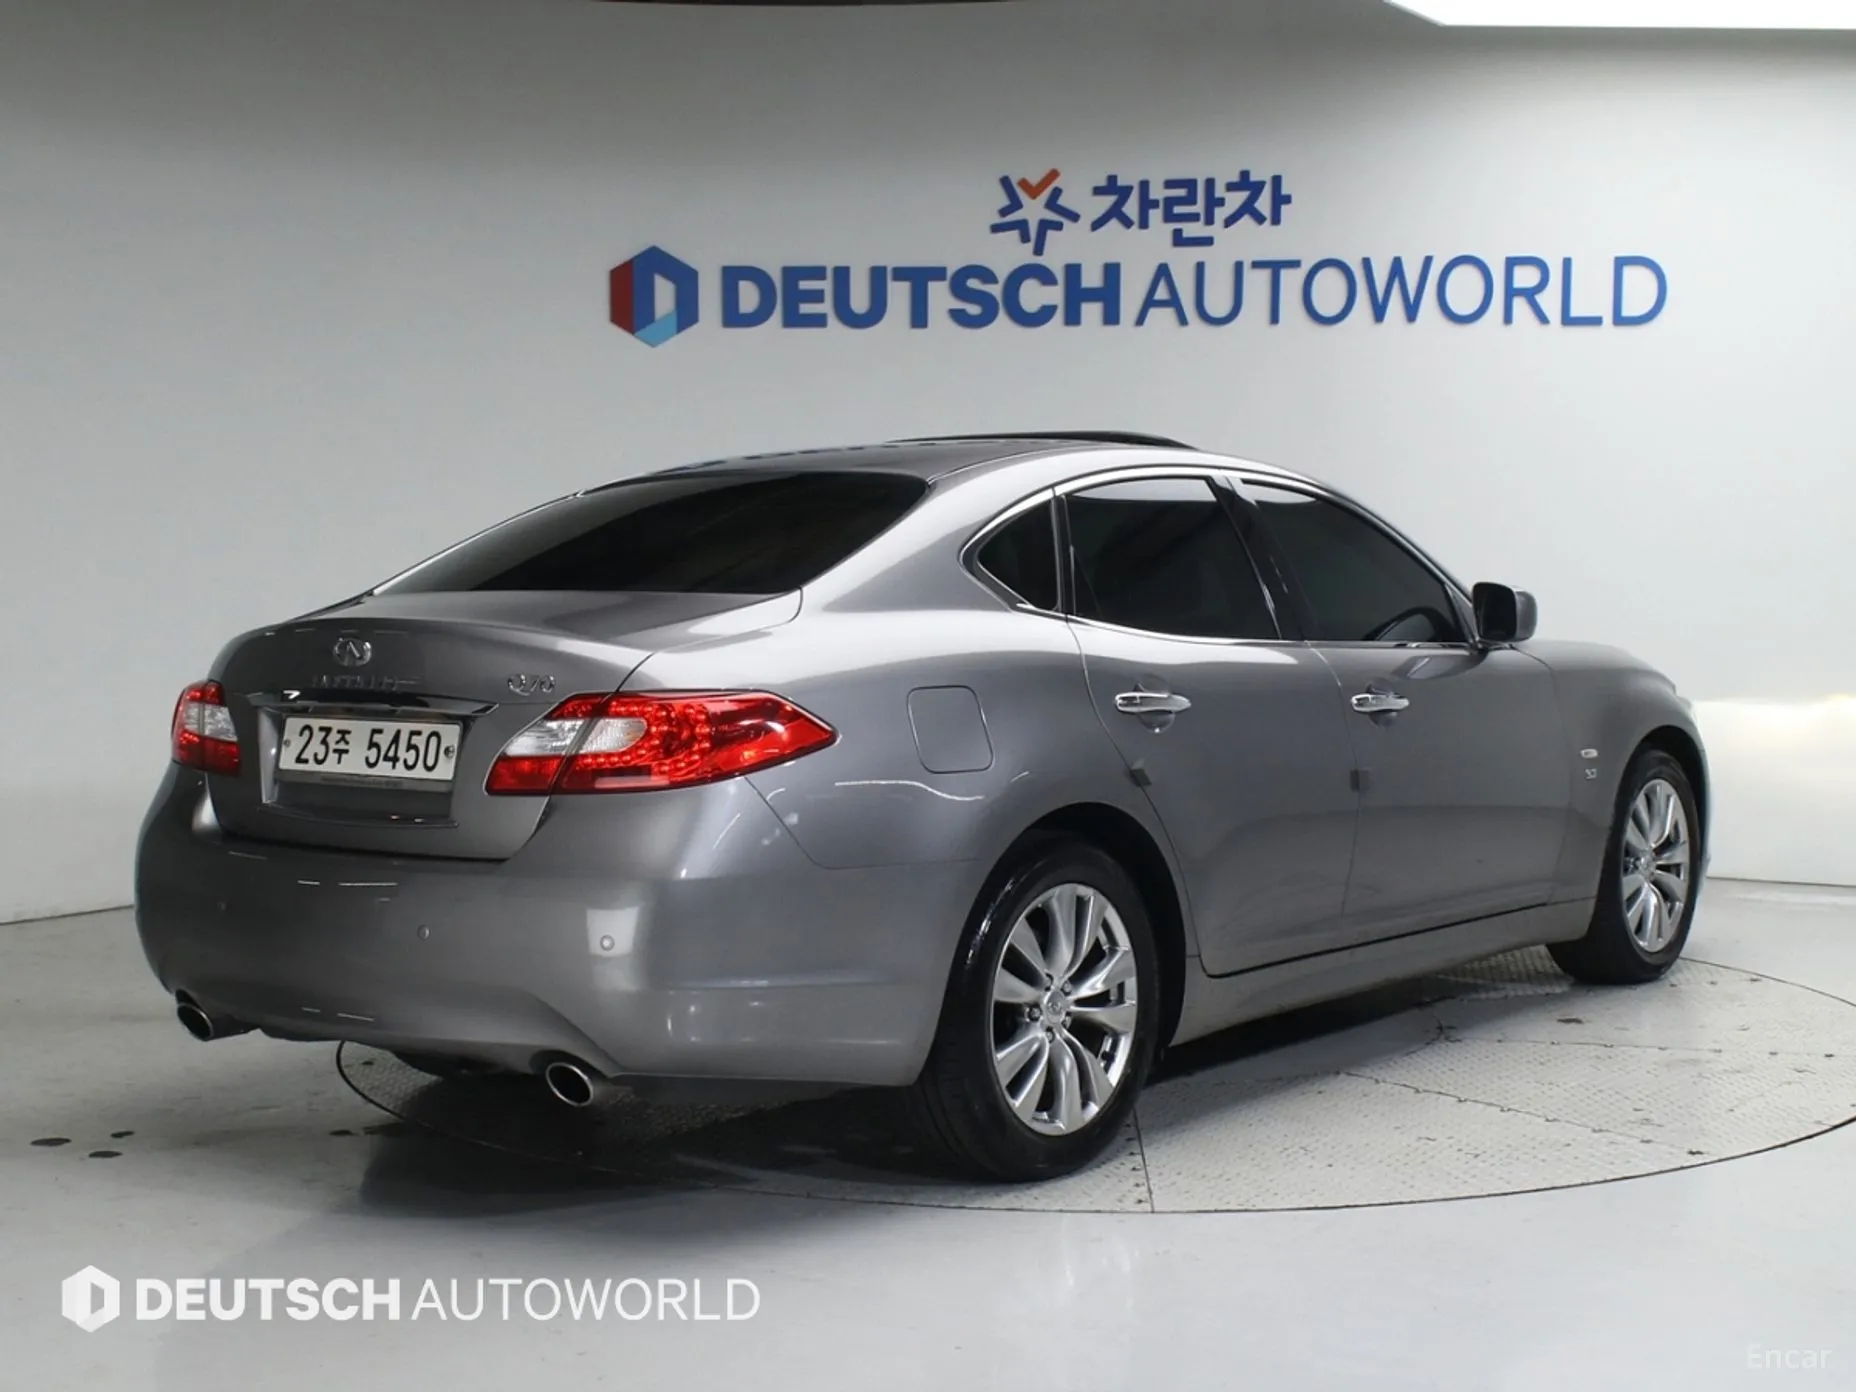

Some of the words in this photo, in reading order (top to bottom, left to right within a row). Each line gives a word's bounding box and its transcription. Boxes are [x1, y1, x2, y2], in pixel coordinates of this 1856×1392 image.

[1091, 169, 1292, 247] 차란차
[721, 263, 1121, 330] DEUTSCH
[1136, 254, 1668, 327] AUTOWORLD
[294, 724, 351, 767] 23주
[364, 728, 443, 773] 5450
